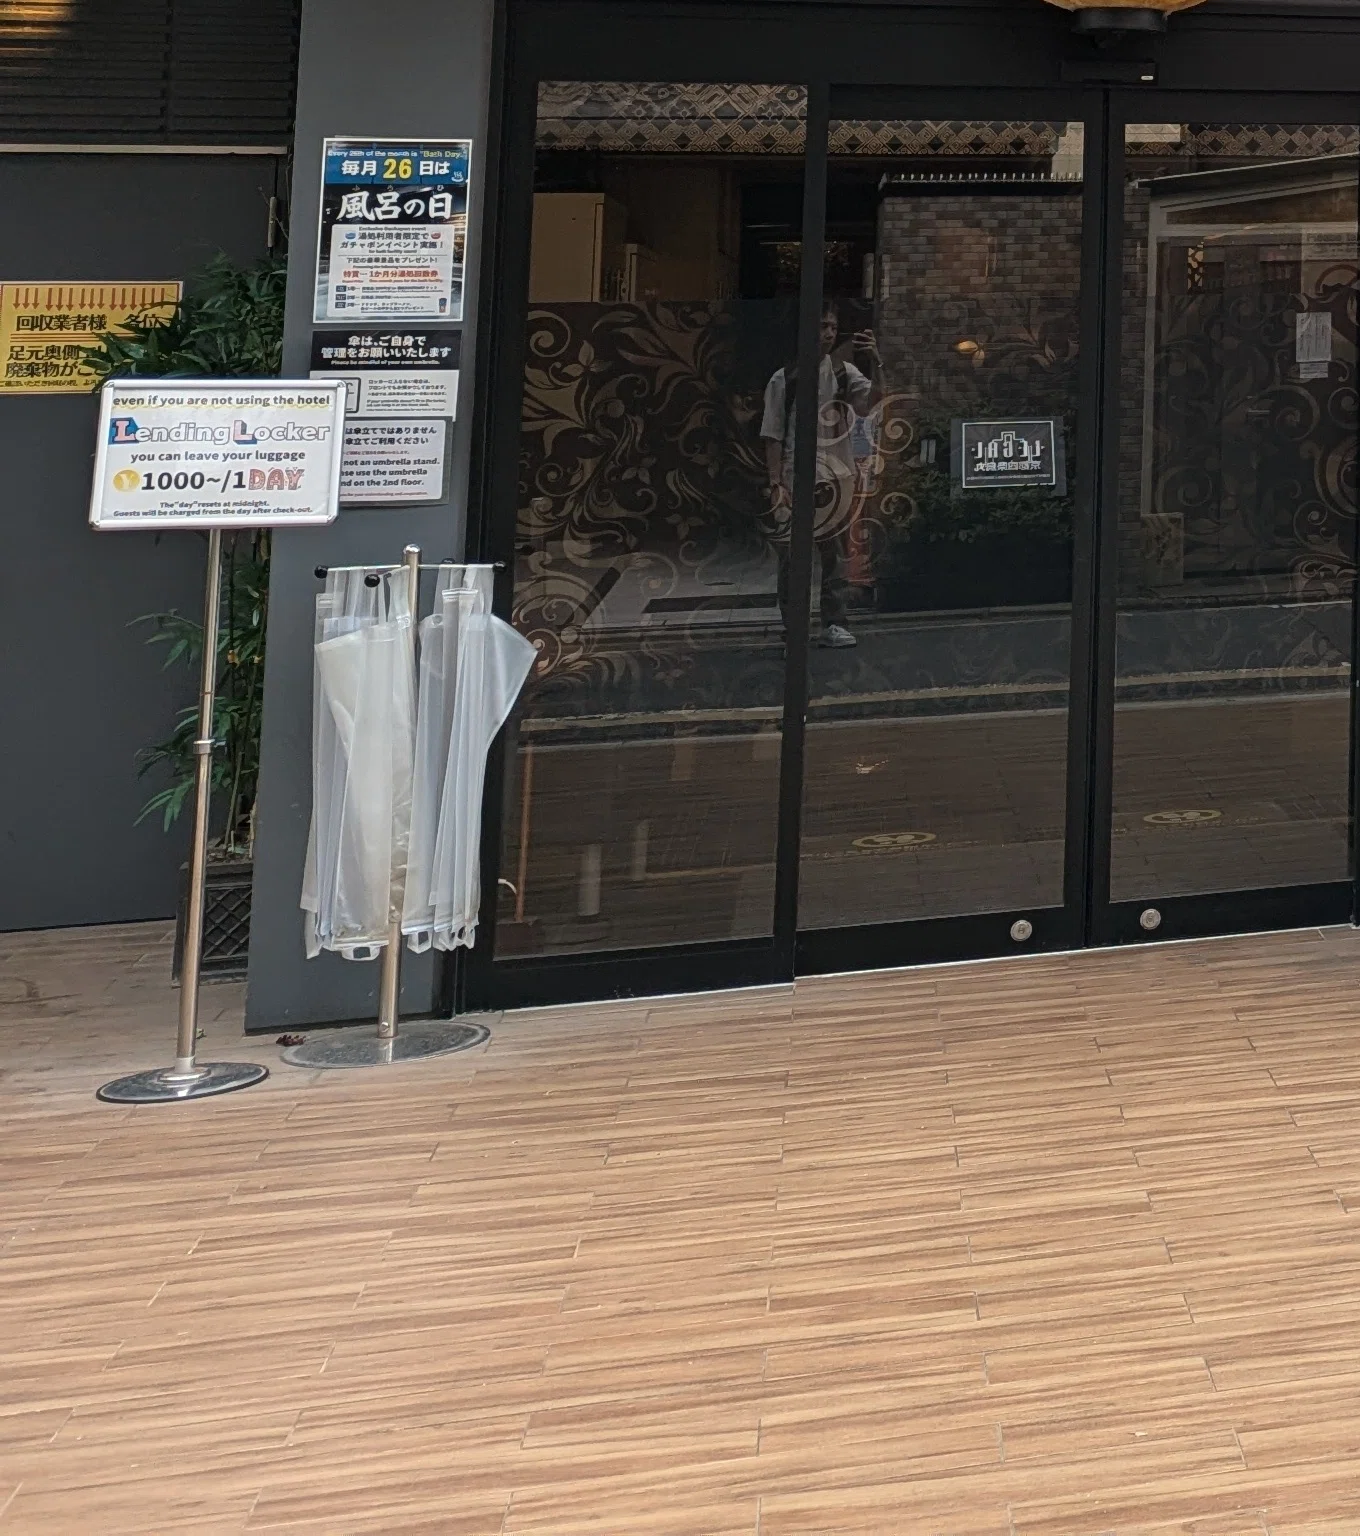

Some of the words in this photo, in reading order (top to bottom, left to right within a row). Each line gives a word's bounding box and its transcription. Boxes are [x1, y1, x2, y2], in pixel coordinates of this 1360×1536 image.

[341, 159, 450, 179] 毎月26日は
[336, 191, 453, 220] 風呂の日
[16, 315, 107, 331] 回収業者様
[322, 347, 451, 358] 管理をお願いいたします
[113, 397, 144, 405] even
[148, 396, 158, 405] if
[160, 397, 183, 409] you
[187, 397, 207, 405] are
[211, 396, 232, 405] not
[236, 396, 269, 408] using
[273, 396, 294, 405] the
[298, 395, 329, 405] hotel
[109, 418, 229, 445] Lending
[233, 420, 330, 444] Locker
[131, 452, 154, 462] you
[158, 452, 179, 461] can
[184, 451, 218, 461] leave
[222, 452, 251, 462] your
[255, 450, 305, 462] luggage
[382, 478, 398, 486] 2nd
[401, 478, 424, 486] floor.
